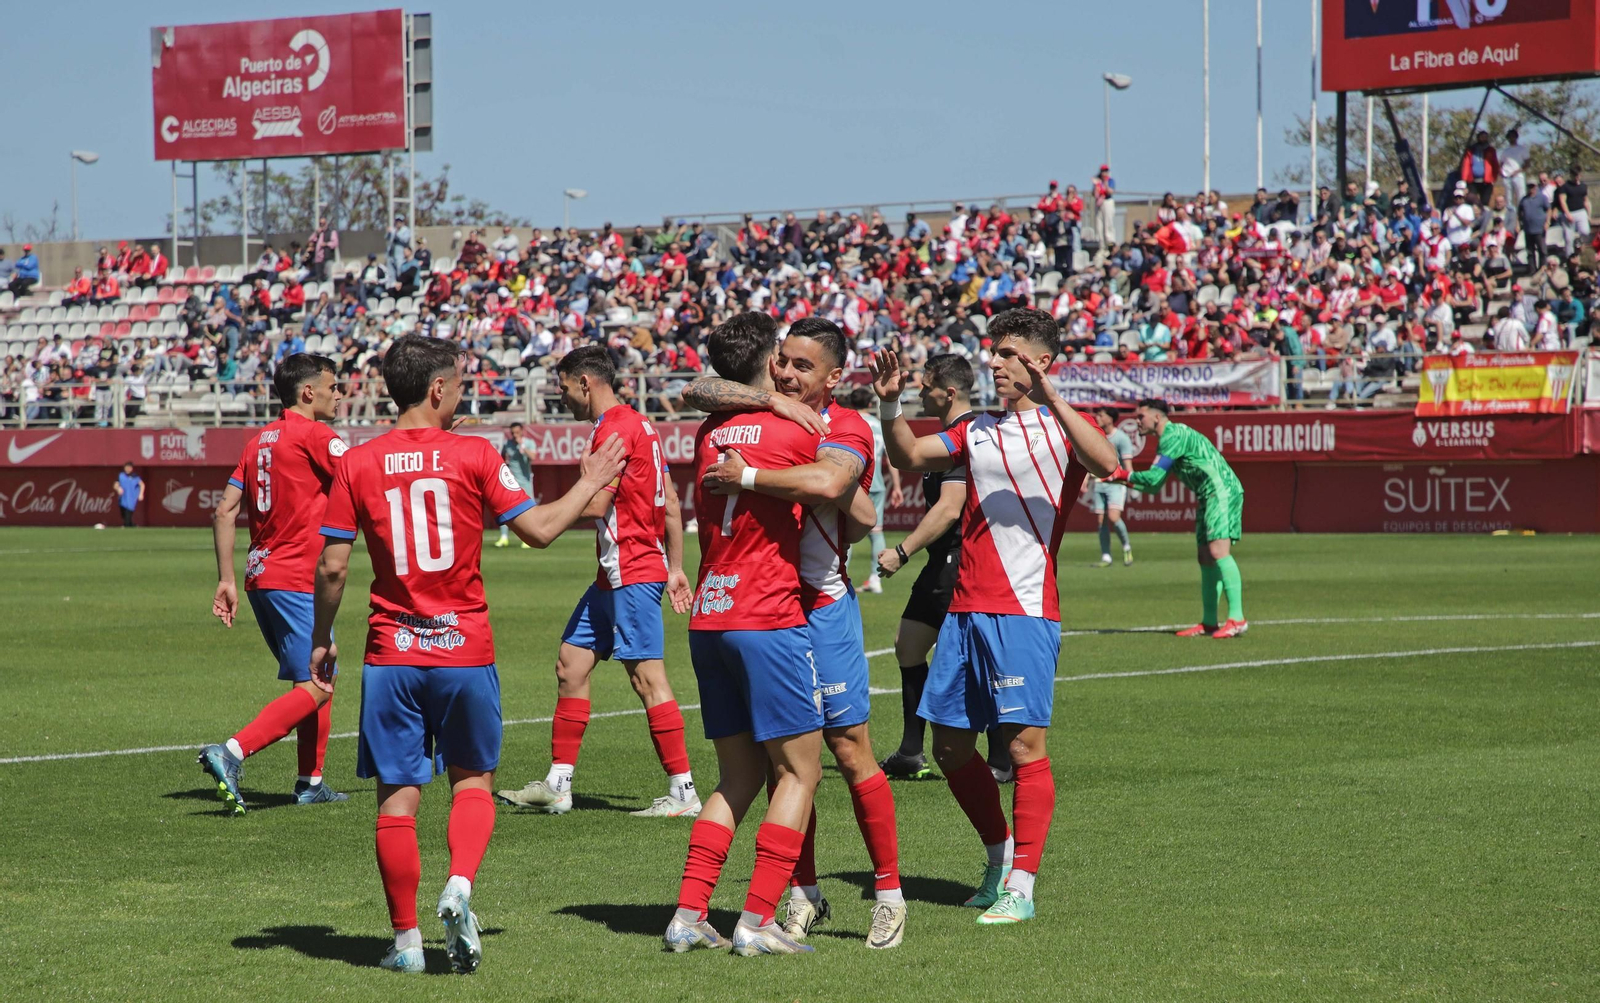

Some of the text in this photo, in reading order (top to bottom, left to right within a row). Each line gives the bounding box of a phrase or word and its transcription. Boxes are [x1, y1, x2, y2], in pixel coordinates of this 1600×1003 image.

[240, 54, 302, 74] Puerto de
[1390, 42, 1520, 71] La Fibra de Aquí
[222, 73, 303, 102] Algeciras
[1489, 378, 1508, 391] Dos
[709, 425, 762, 448] ESCUDERO
[1235, 419, 1336, 452] FEDERACIÓN
[1427, 421, 1495, 438] VERSUS
[1435, 437, 1490, 447] E-LEARNING
[384, 450, 444, 475] DIEGO E.
[11, 478, 116, 515] Casa Mané
[1126, 507, 1182, 520] Permotor
[384, 477, 455, 576] 10
[1383, 521, 1512, 533] EQUIPOS DE DESCANSO
[419, 629, 466, 651] Gusta
